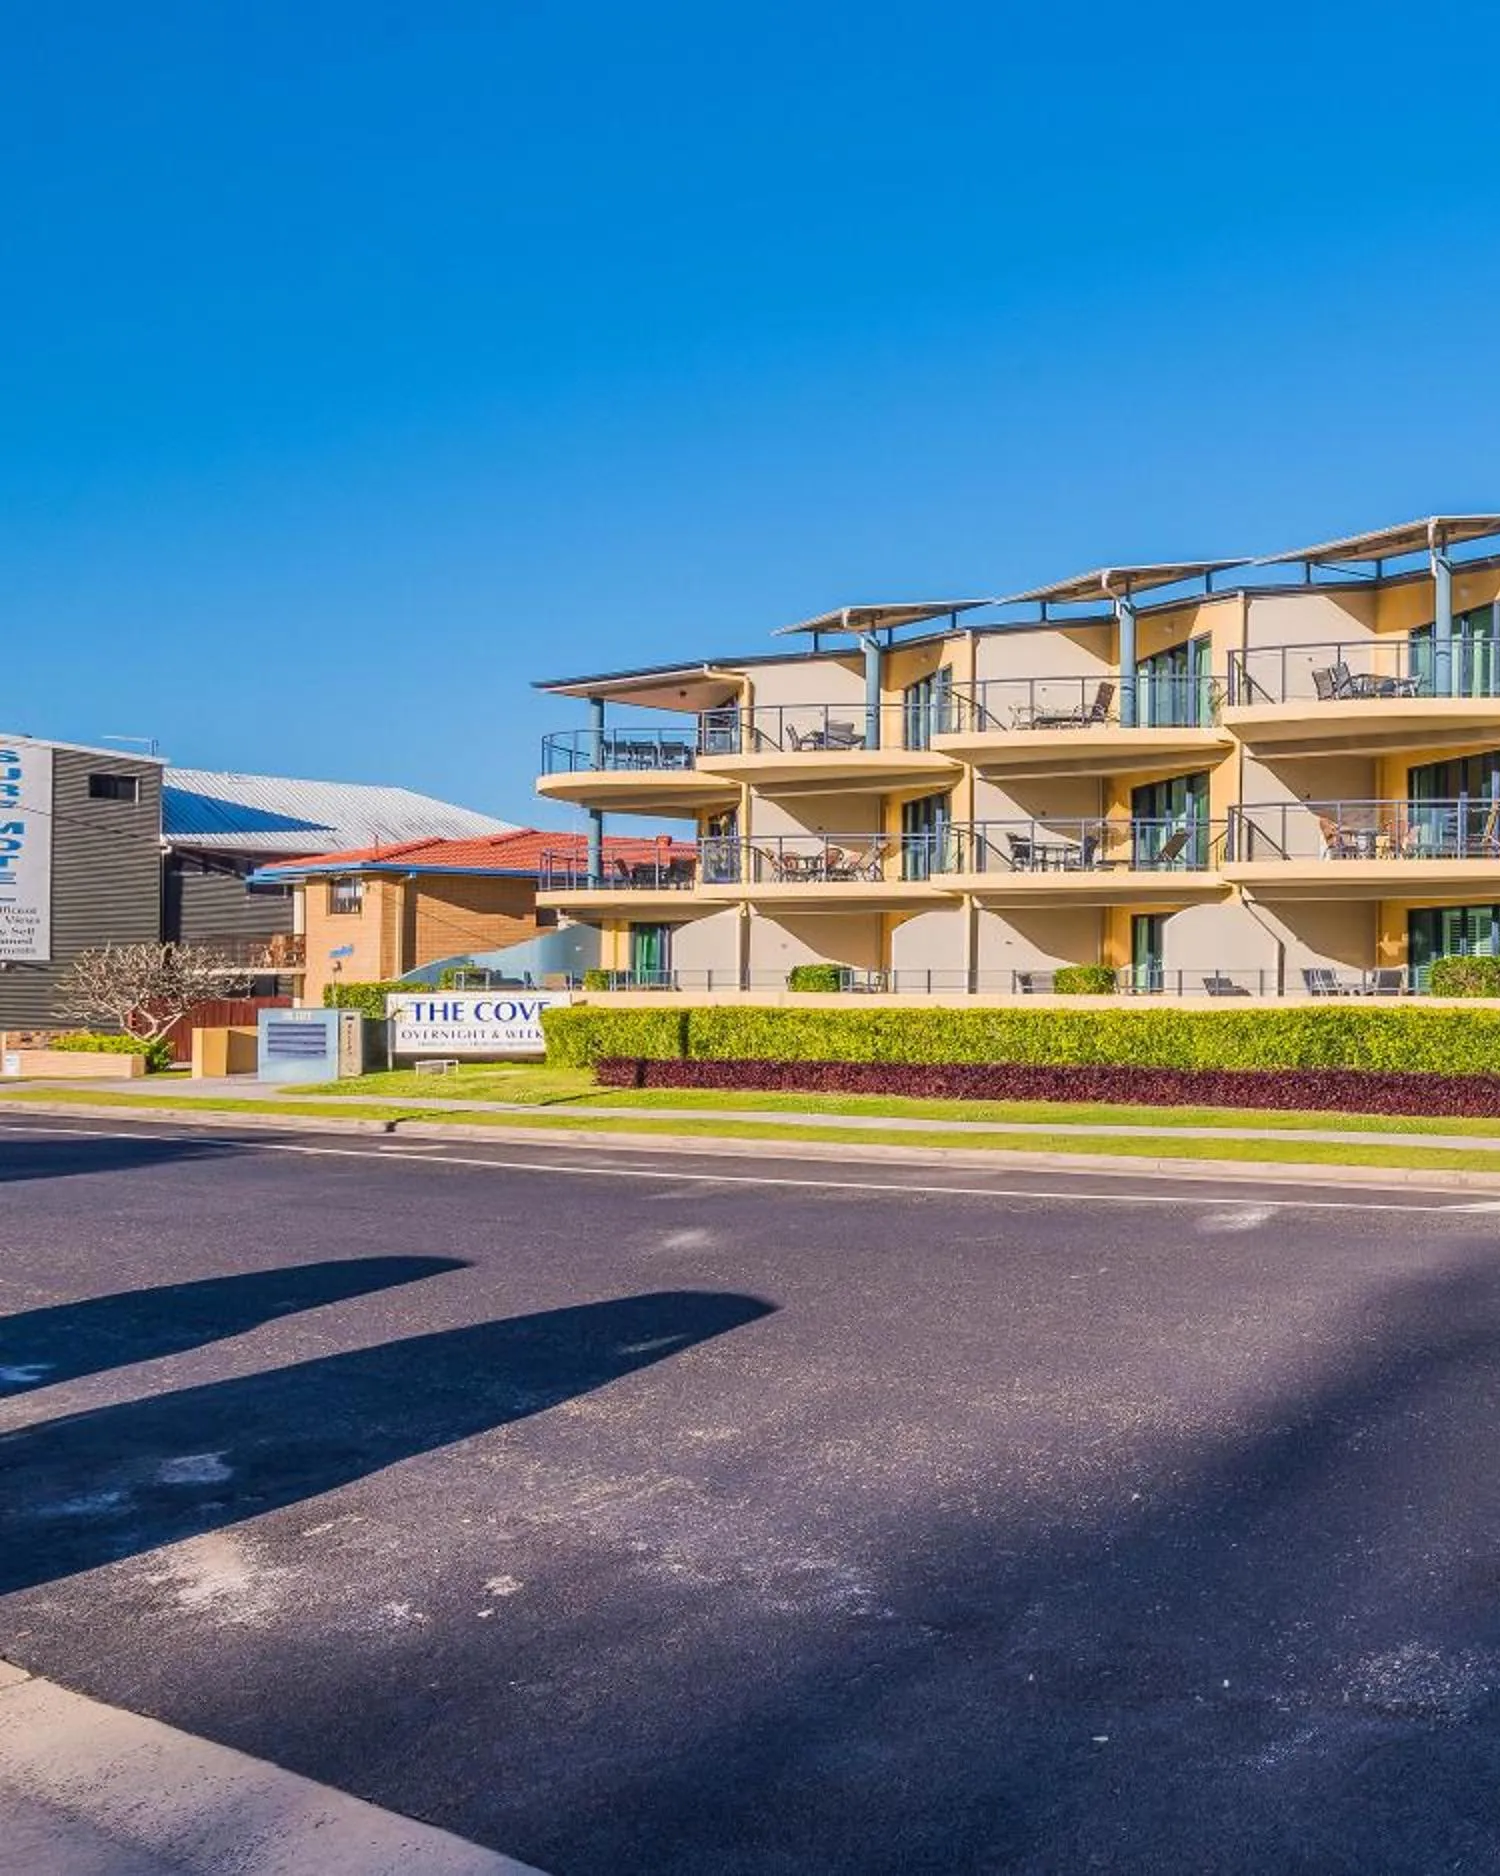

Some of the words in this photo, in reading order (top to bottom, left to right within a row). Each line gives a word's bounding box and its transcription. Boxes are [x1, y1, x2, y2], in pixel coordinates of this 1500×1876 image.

[410, 1001, 465, 1022] THE
[401, 1029, 486, 1039] OVERNIGHT
[504, 1029, 543, 1039] WEEK
